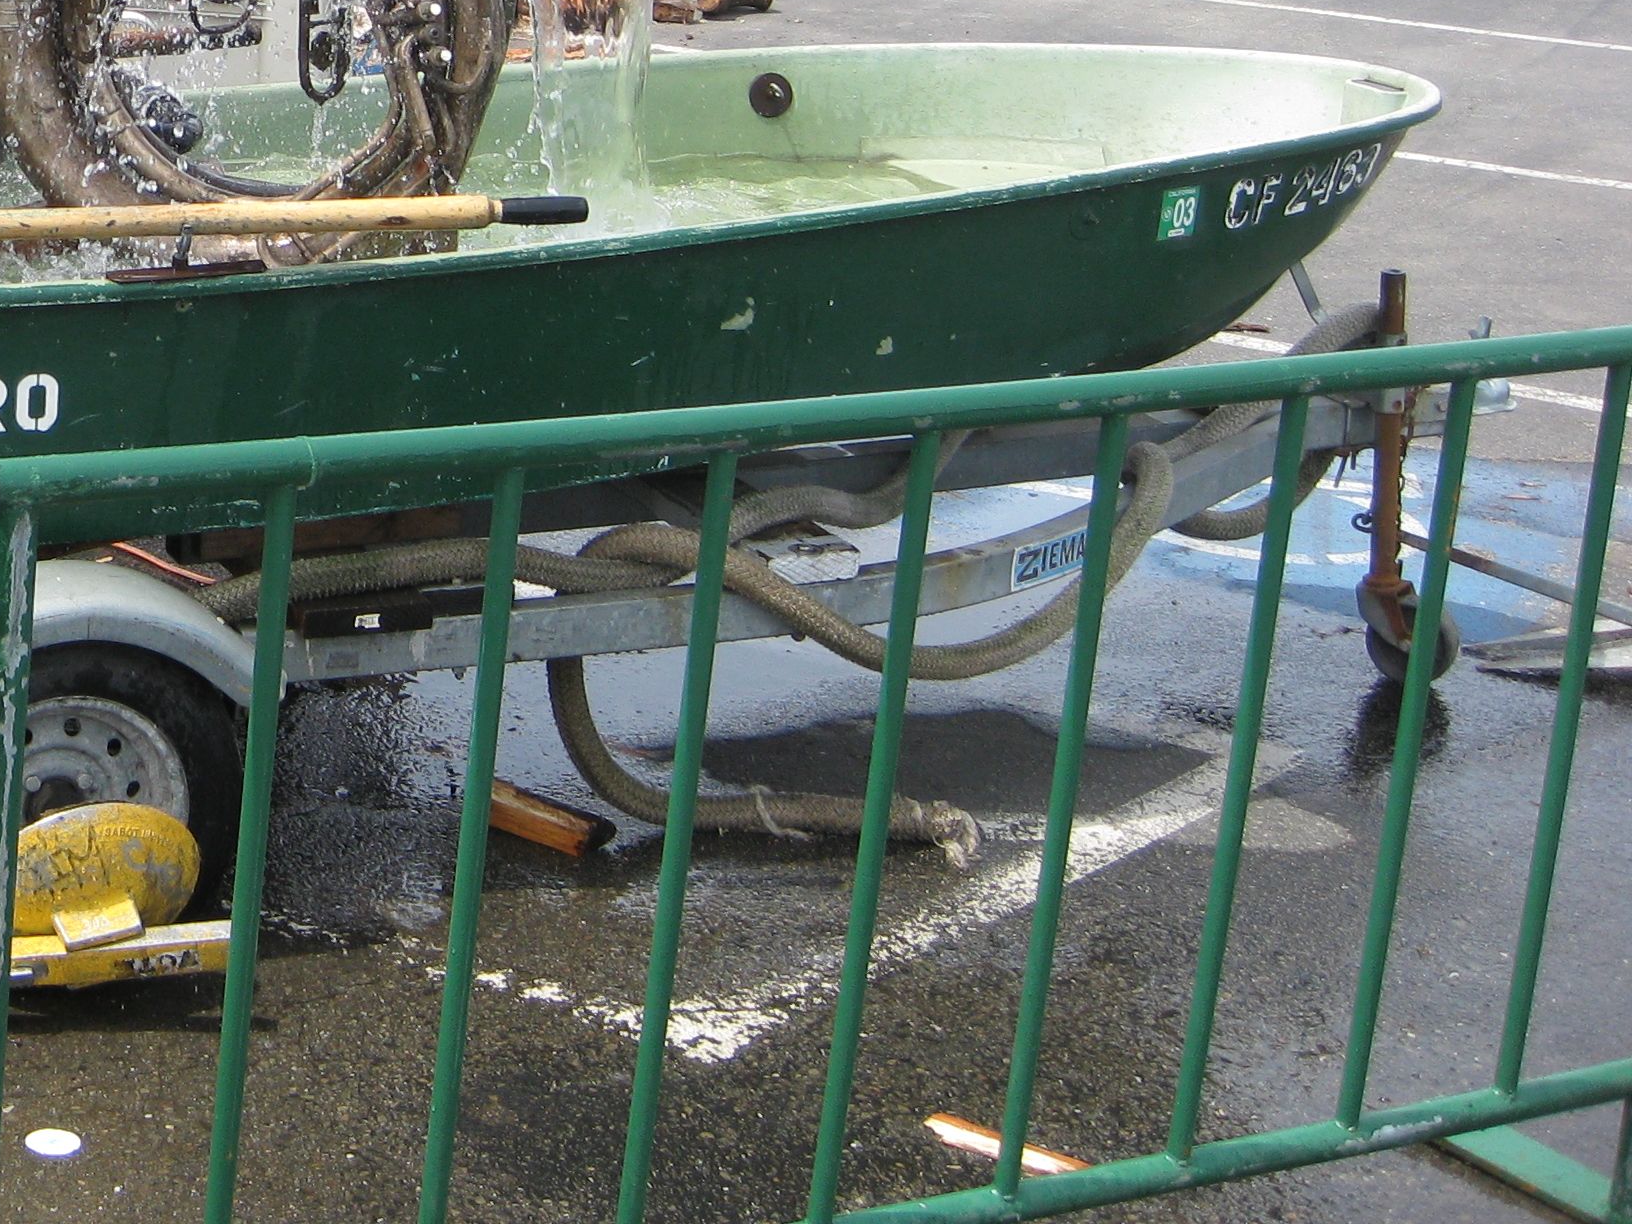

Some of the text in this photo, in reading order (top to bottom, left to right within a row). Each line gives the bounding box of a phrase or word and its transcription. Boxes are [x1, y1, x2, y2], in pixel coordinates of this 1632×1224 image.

[1173, 196, 1196, 228] 03
[1224, 173, 1283, 229] CF
[1016, 532, 1087, 584] ZIEMA
